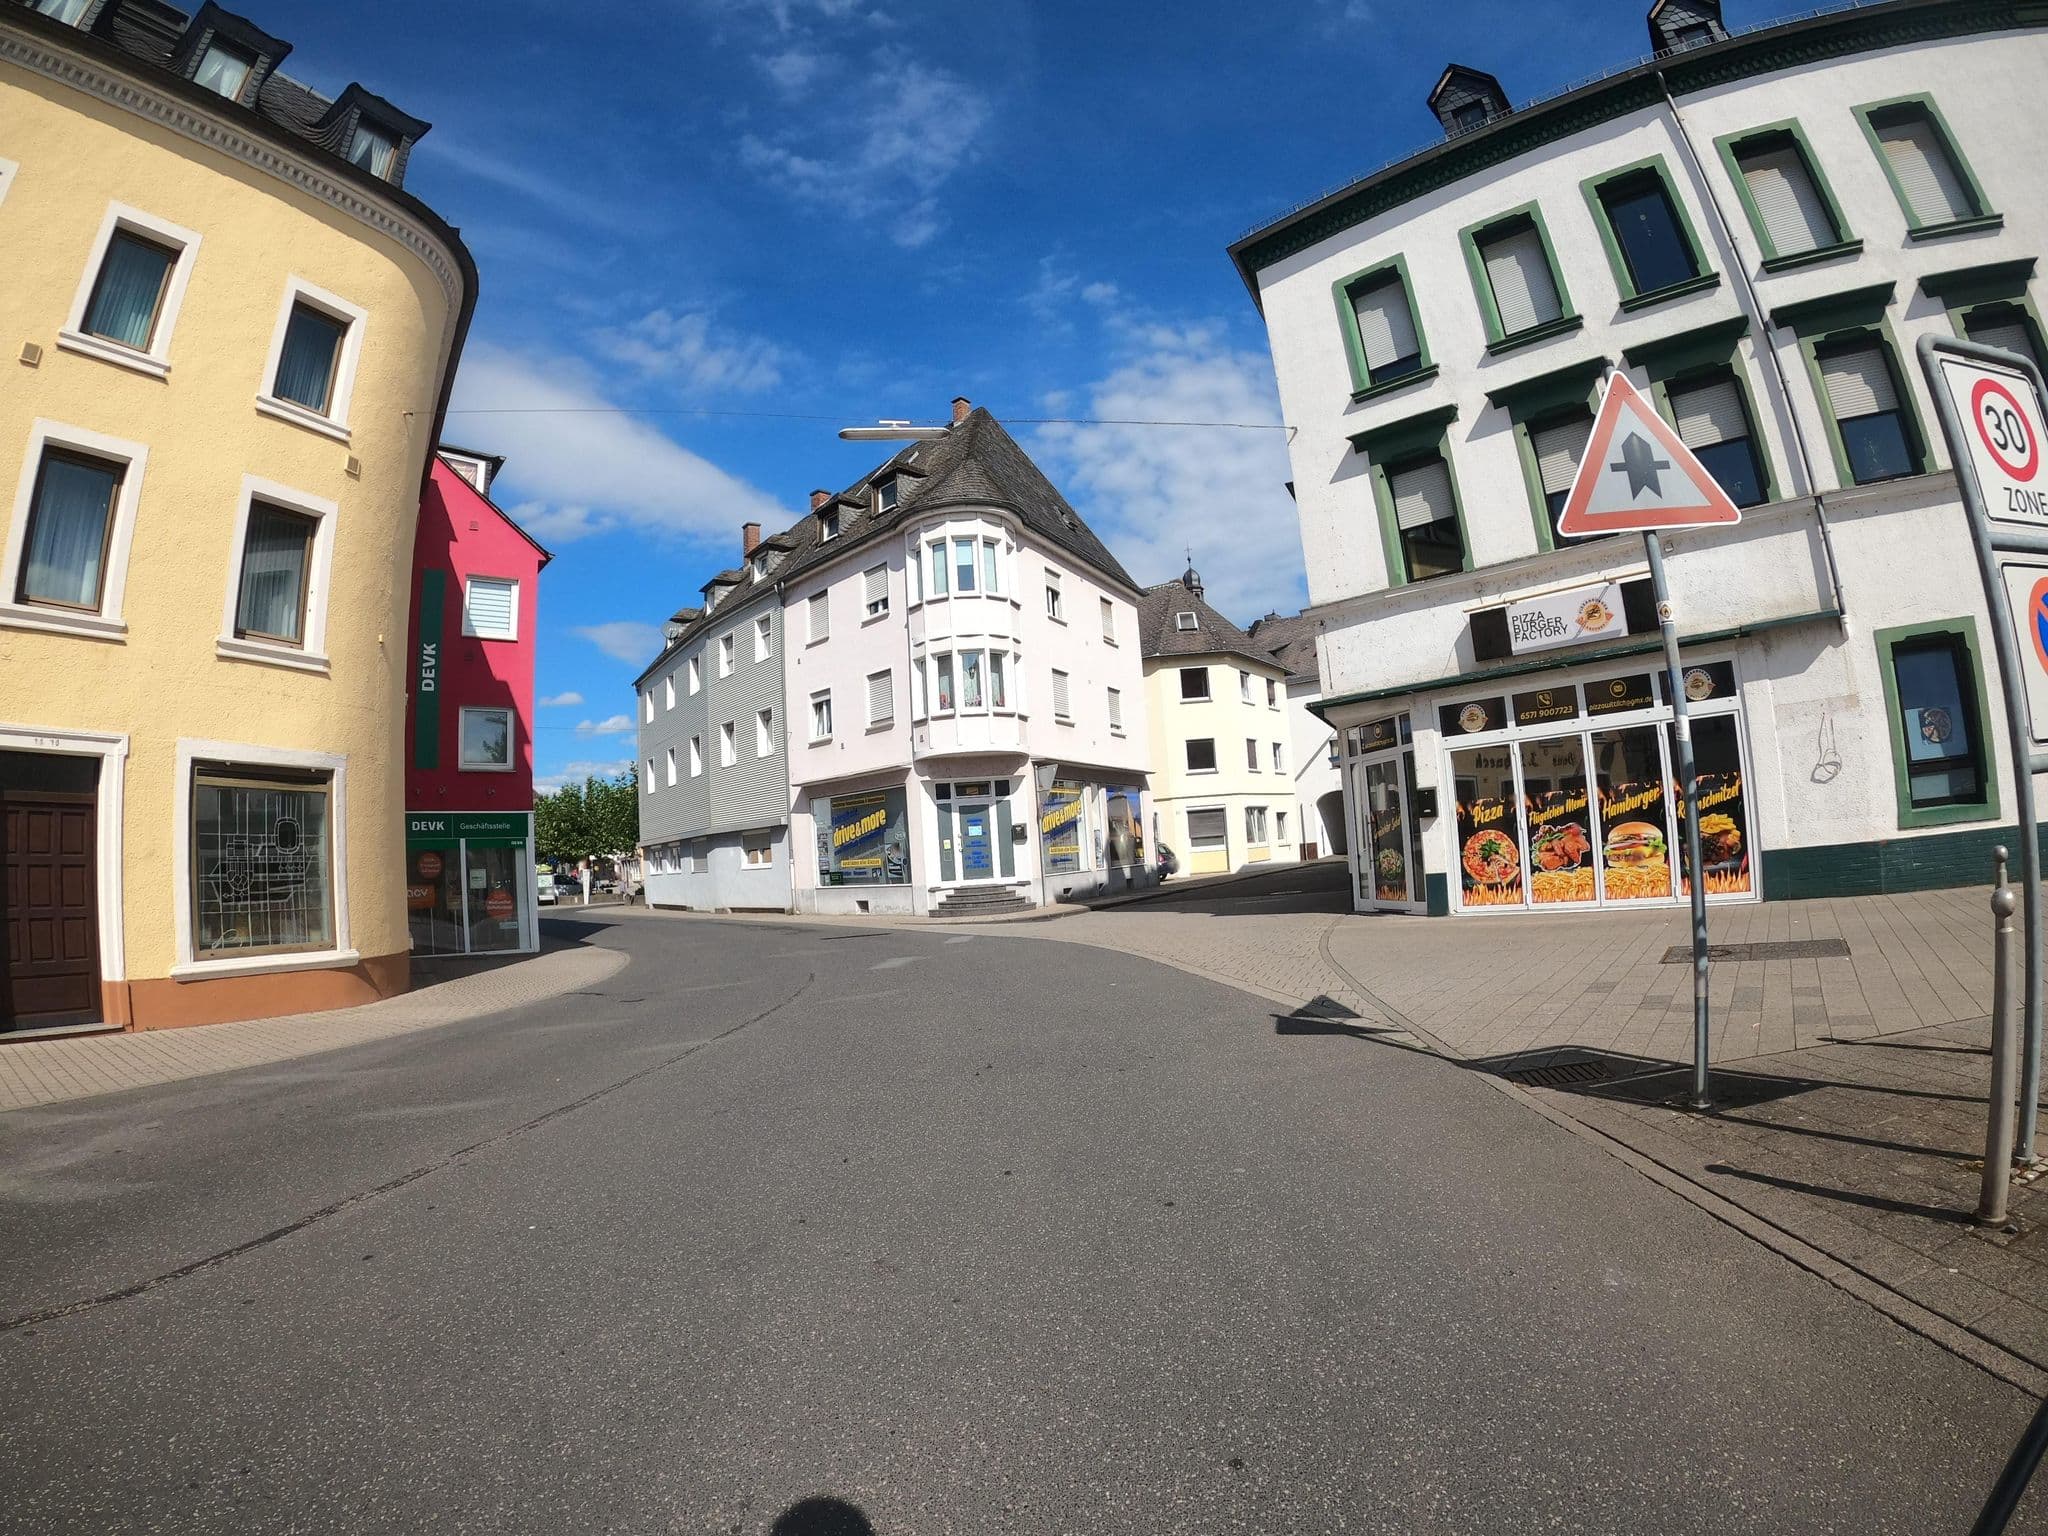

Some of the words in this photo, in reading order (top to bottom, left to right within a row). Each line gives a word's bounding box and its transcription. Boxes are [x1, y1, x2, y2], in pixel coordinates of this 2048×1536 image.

[1985, 405, 2026, 454] 30
[2003, 486, 2048, 516] ZONE
[1511, 610, 1545, 627] PIZZA
[1513, 616, 1563, 635] BURGER
[1514, 624, 1568, 643] FACTORY
[421, 643, 436, 692] DEVK
[1520, 711, 1538, 721] 6571
[1539, 705, 1573, 719] 9007723
[1042, 799, 1082, 834] drive&more
[1472, 804, 1504, 828] Pizza
[1602, 785, 1661, 822] Hamburger
[411, 821, 445, 831] DEVK
[459, 822, 511, 831] Geschäftsstelle
[833, 808, 886, 848] drive&more
